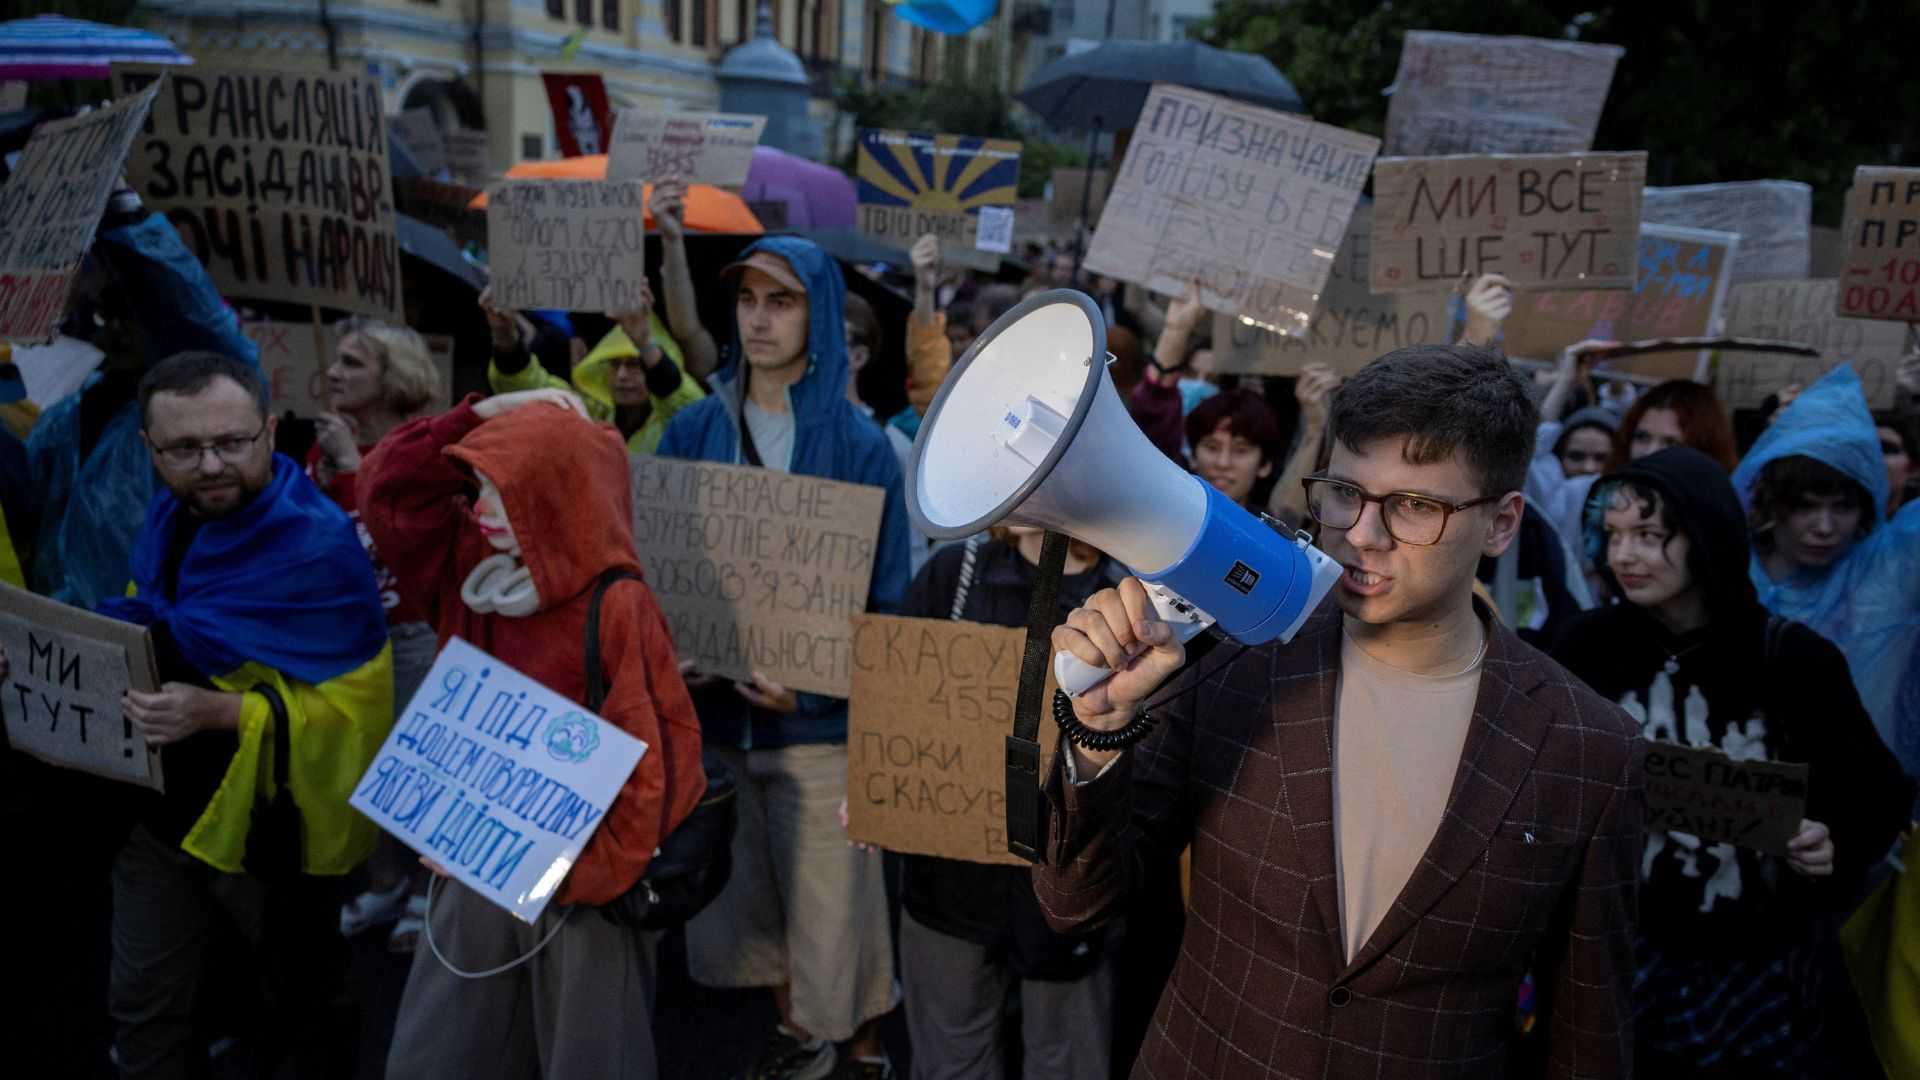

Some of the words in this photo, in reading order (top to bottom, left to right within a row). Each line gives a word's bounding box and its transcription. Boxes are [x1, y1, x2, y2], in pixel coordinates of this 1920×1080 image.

[1408, 175, 1497, 224] МИ
[1519, 168, 1605, 217] ВСЕ
[281, 211, 397, 313] НАРОДУ
[1531, 227, 1612, 280] ТУТ
[680, 464, 838, 521] ПРЕКРАСНЕ
[781, 522, 873, 570] ЖИТТЯ
[28, 632, 80, 691] МИ
[430, 665, 468, 714] Я
[474, 690, 548, 750] ПІД
[396, 711, 487, 782] ДОЩЕМ
[861, 730, 966, 773] ПОКИ
[423, 789, 536, 891] ІДІОТИ
